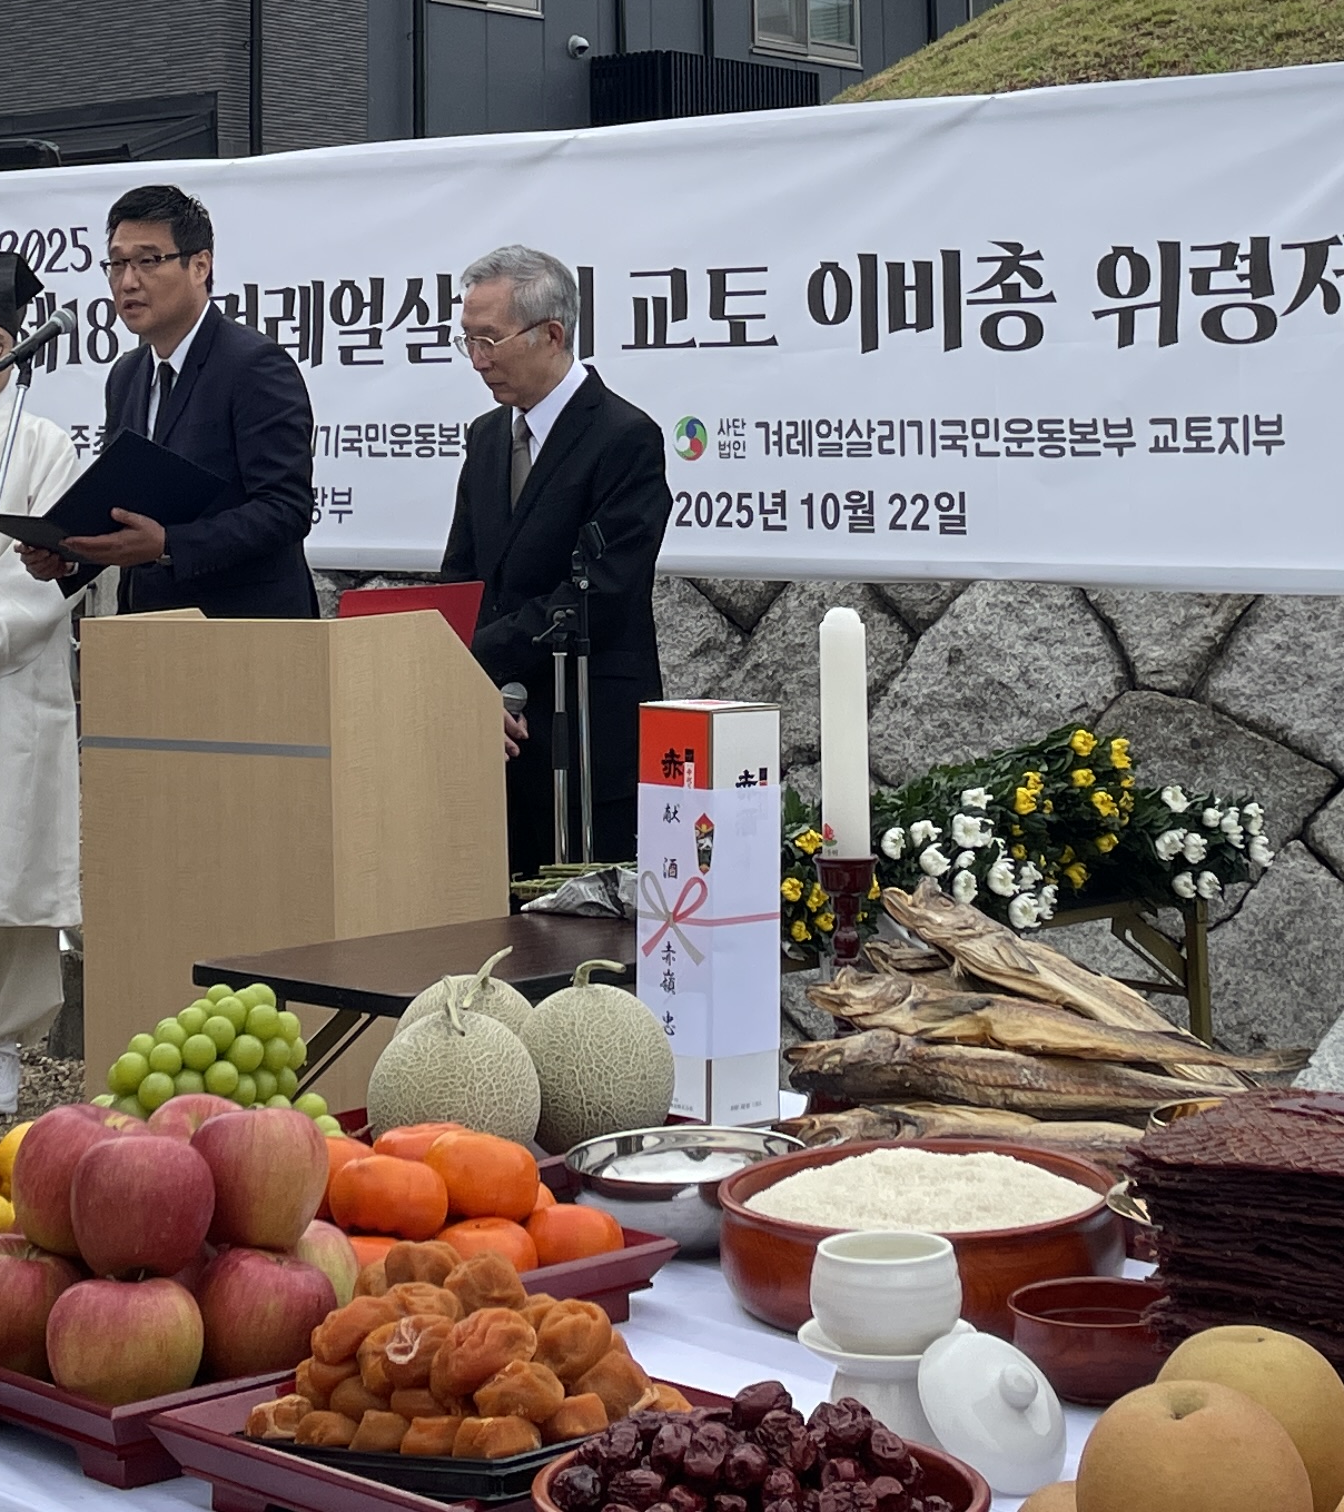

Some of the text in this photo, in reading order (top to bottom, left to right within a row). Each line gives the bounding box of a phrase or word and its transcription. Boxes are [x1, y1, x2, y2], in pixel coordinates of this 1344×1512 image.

[621, 266, 779, 350] 교토
[807, 240, 1057, 354] 이비총
[717, 417, 747, 437] 사단
[717, 440, 747, 459] 법인
[755, 413, 1286, 459] 겨레얼살리기국민운동본부 교토지부
[674, 489, 968, 535] 2025년 10월 22일
